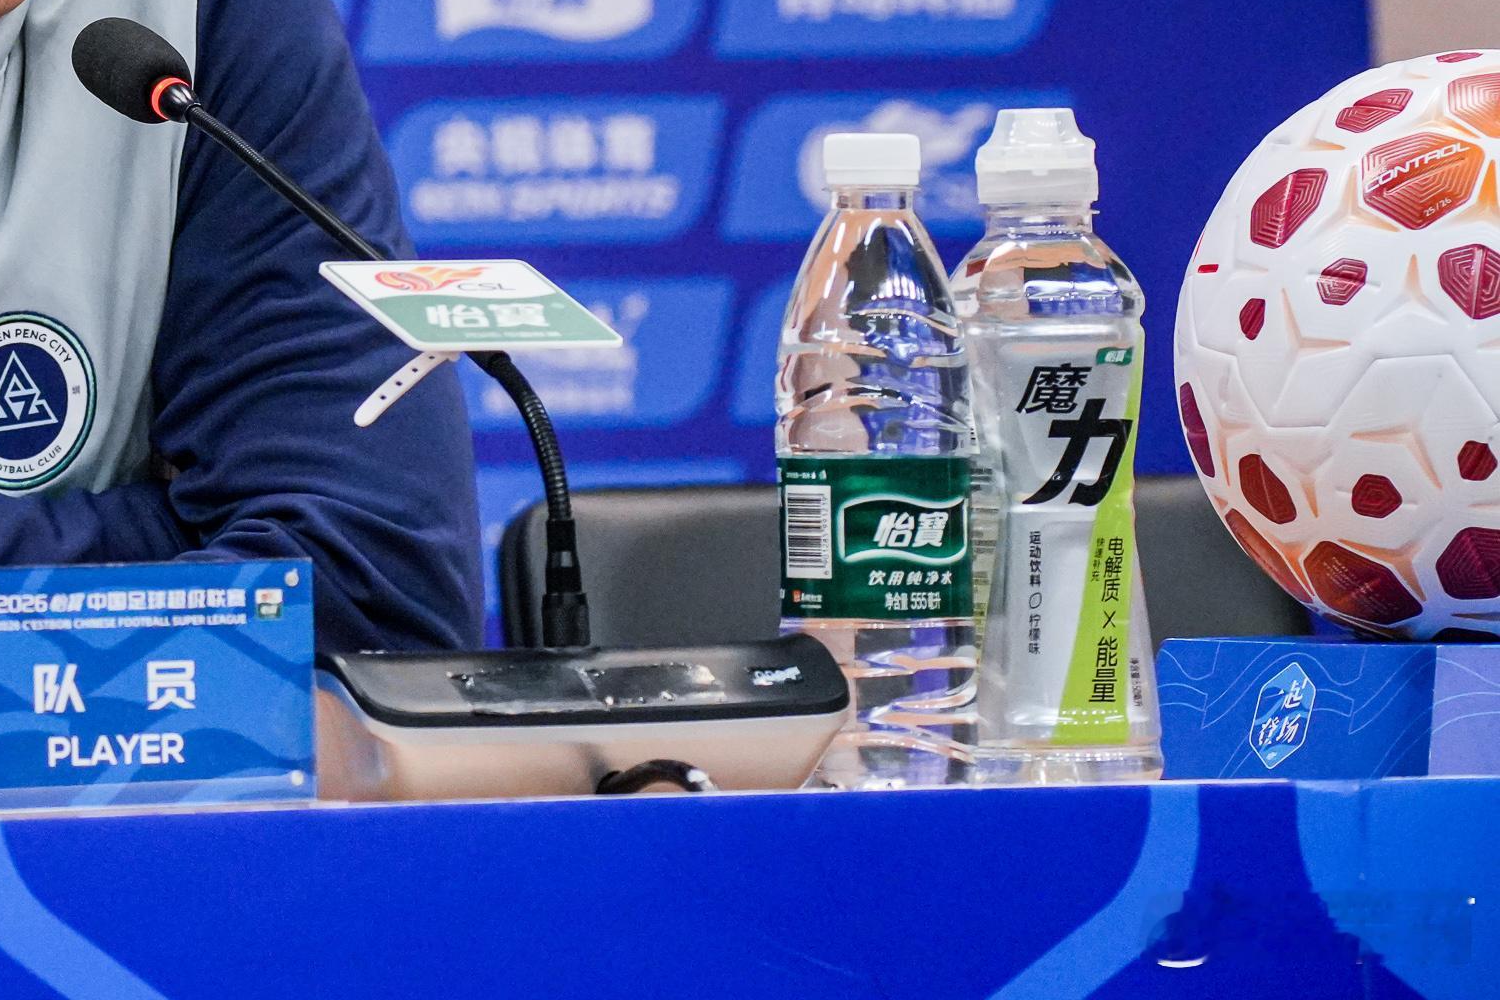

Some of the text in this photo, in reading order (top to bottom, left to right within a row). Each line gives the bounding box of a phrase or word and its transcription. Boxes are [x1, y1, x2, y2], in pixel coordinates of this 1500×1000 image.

[1365, 142, 1471, 194] CONTROL
[456, 282, 517, 292] CSL
[14, 328, 48, 343] PENG
[49, 338, 73, 364] CITY
[37, 444, 63, 467] CLUB
[868, 570, 953, 586] 饮用纯净水
[1029, 531, 1042, 587] 运动饮料
[1101, 536, 1125, 603] 电解质
[1028, 614, 1041, 655] 柠檬味
[1088, 636, 1119, 703] 能量
[47, 733, 186, 768] PLAYER
